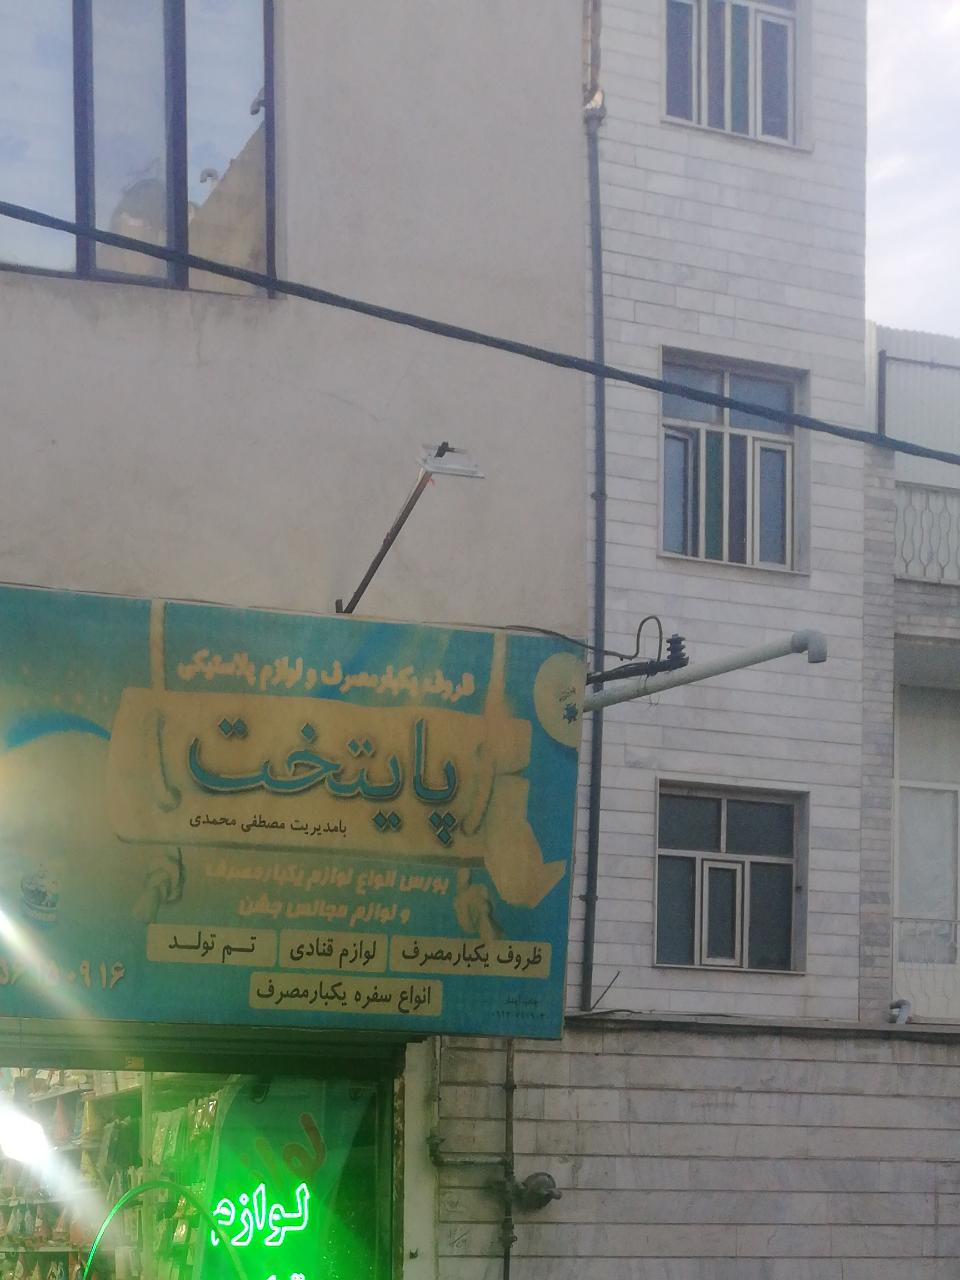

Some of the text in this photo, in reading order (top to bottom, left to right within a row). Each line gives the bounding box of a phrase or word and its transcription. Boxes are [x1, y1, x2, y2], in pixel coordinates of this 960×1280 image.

[187, 717, 458, 847] پایتخت
[189, 813, 237, 828] محمدی
[241, 813, 285, 833] مصطفی
[306, 866, 354, 891] لوازم
[286, 899, 348, 922] مجالس
[350, 902, 397, 927] لوازم
[167, 930, 257, 964] تم تولد
[289, 937, 377, 969] لوازم قنادی
[495, 944, 543, 972] ظروف
[353, 987, 393, 1010] سفره
[397, 985, 432, 1014] انواع
[211, 1182, 310, 1247] لوازم
